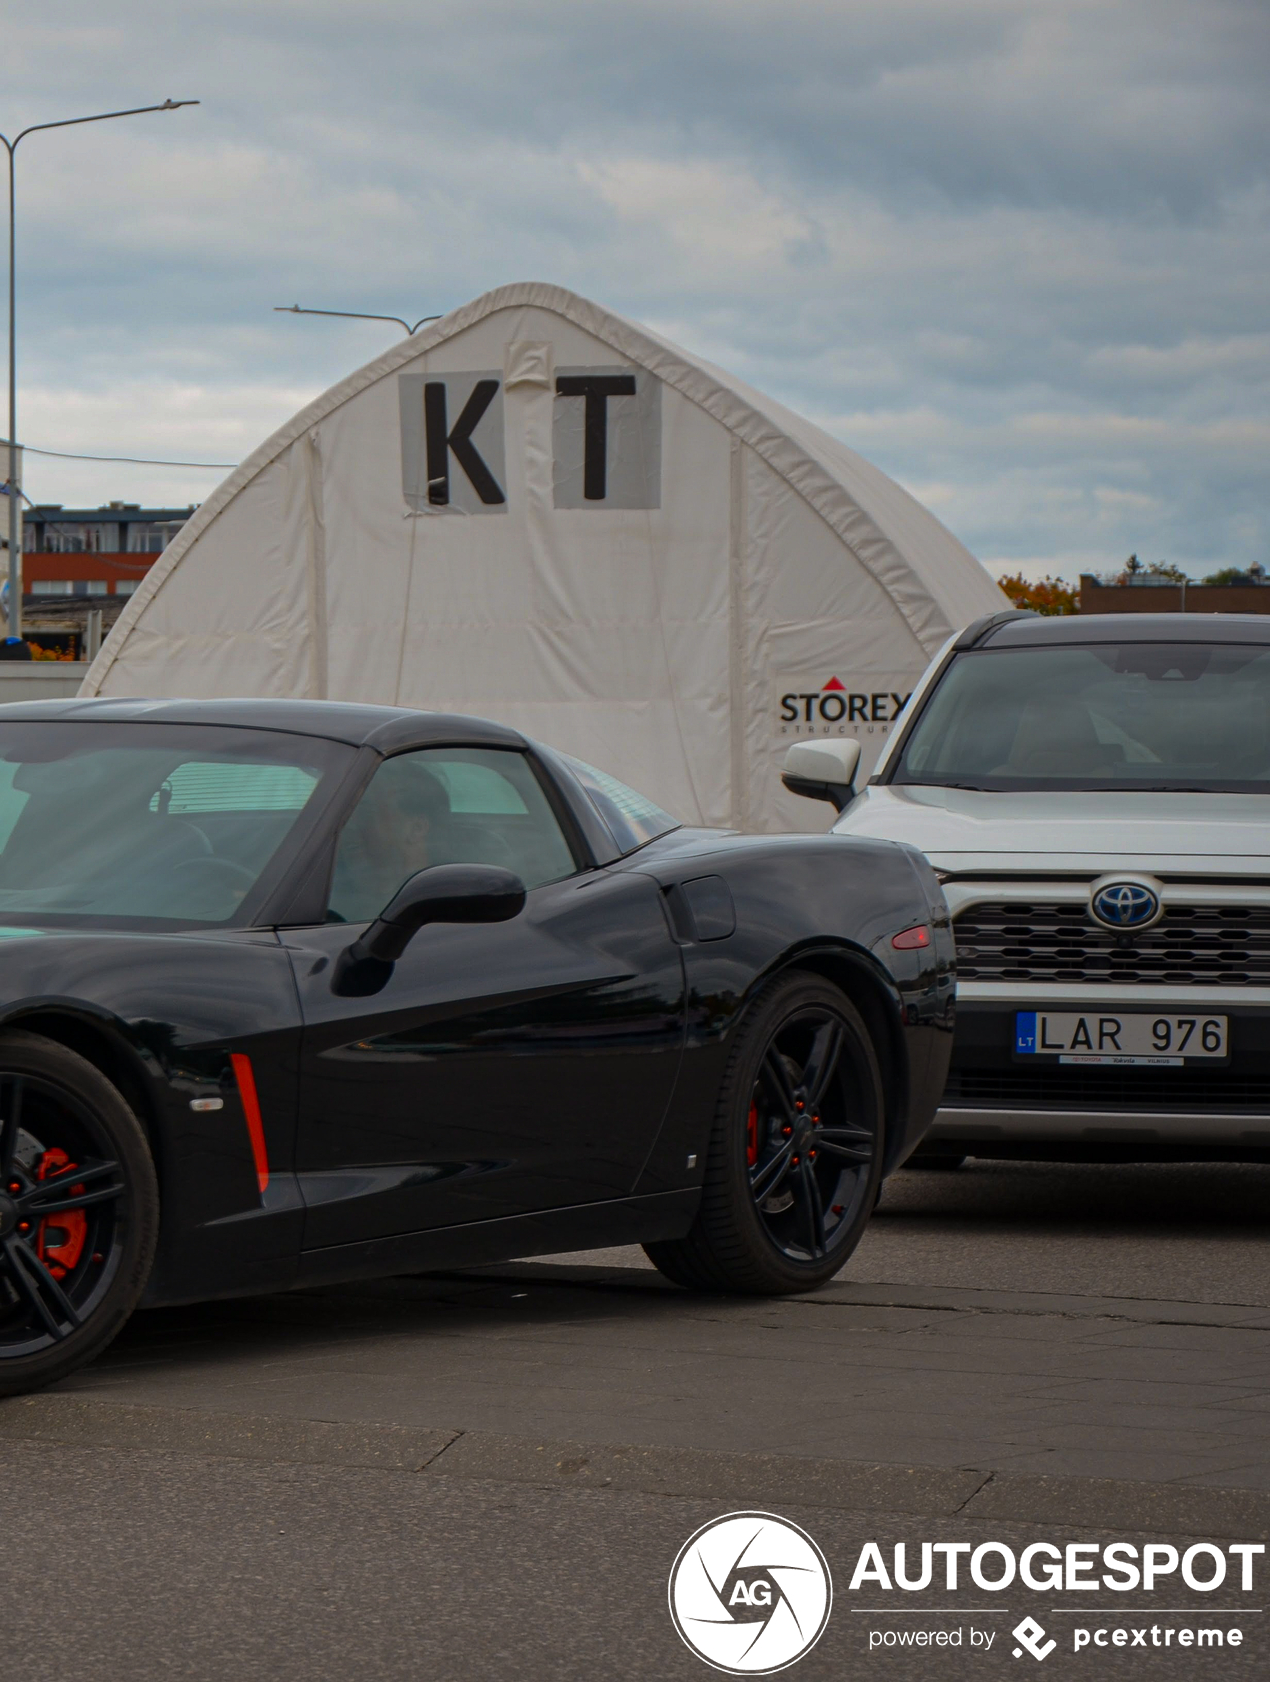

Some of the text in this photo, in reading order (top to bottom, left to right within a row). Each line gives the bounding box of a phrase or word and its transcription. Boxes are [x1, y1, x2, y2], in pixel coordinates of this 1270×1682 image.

[781, 692, 912, 722] STOREX
[1018, 1016, 1221, 1052] LT LAR 976
